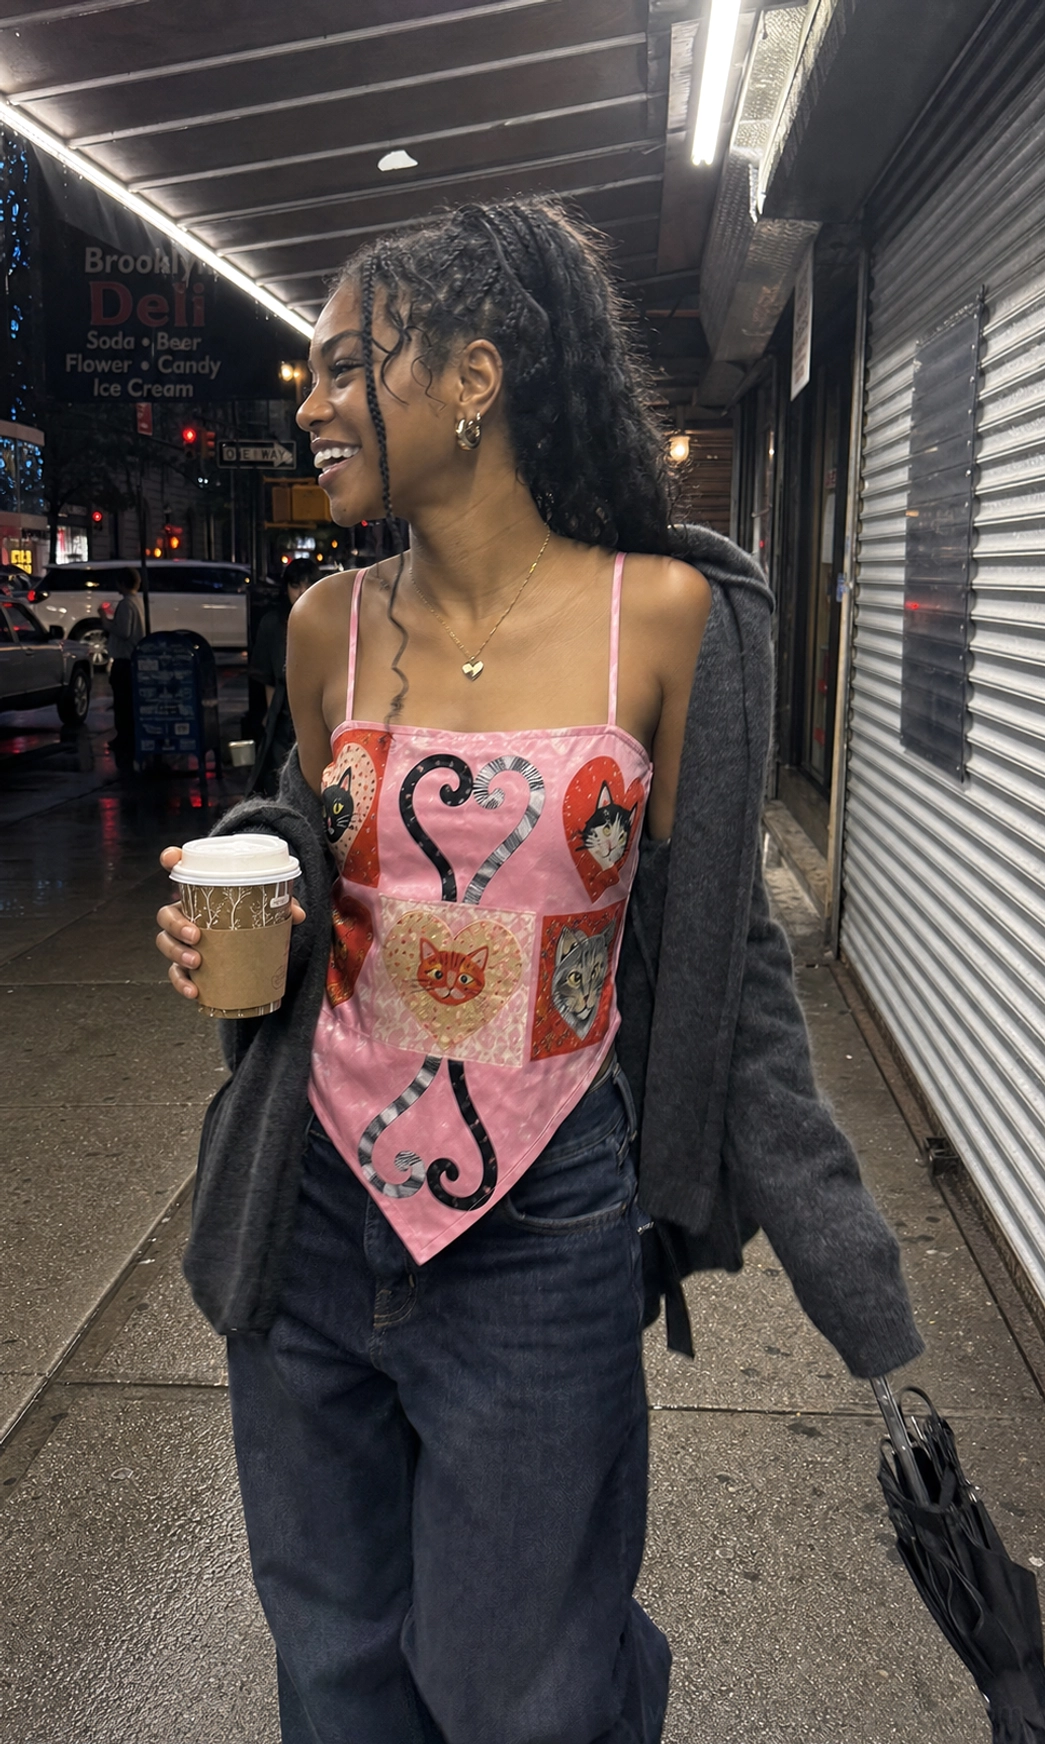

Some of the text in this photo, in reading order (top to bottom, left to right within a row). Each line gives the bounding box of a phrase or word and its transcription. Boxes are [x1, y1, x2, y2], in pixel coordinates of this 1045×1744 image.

[88, 280, 206, 328] Deli
[86, 330, 202, 351] Soda Beer
[65, 353, 222, 381] Flower Candy
[93, 377, 194, 398] Ice Cream
[226, 449, 285, 460] OE WAY
